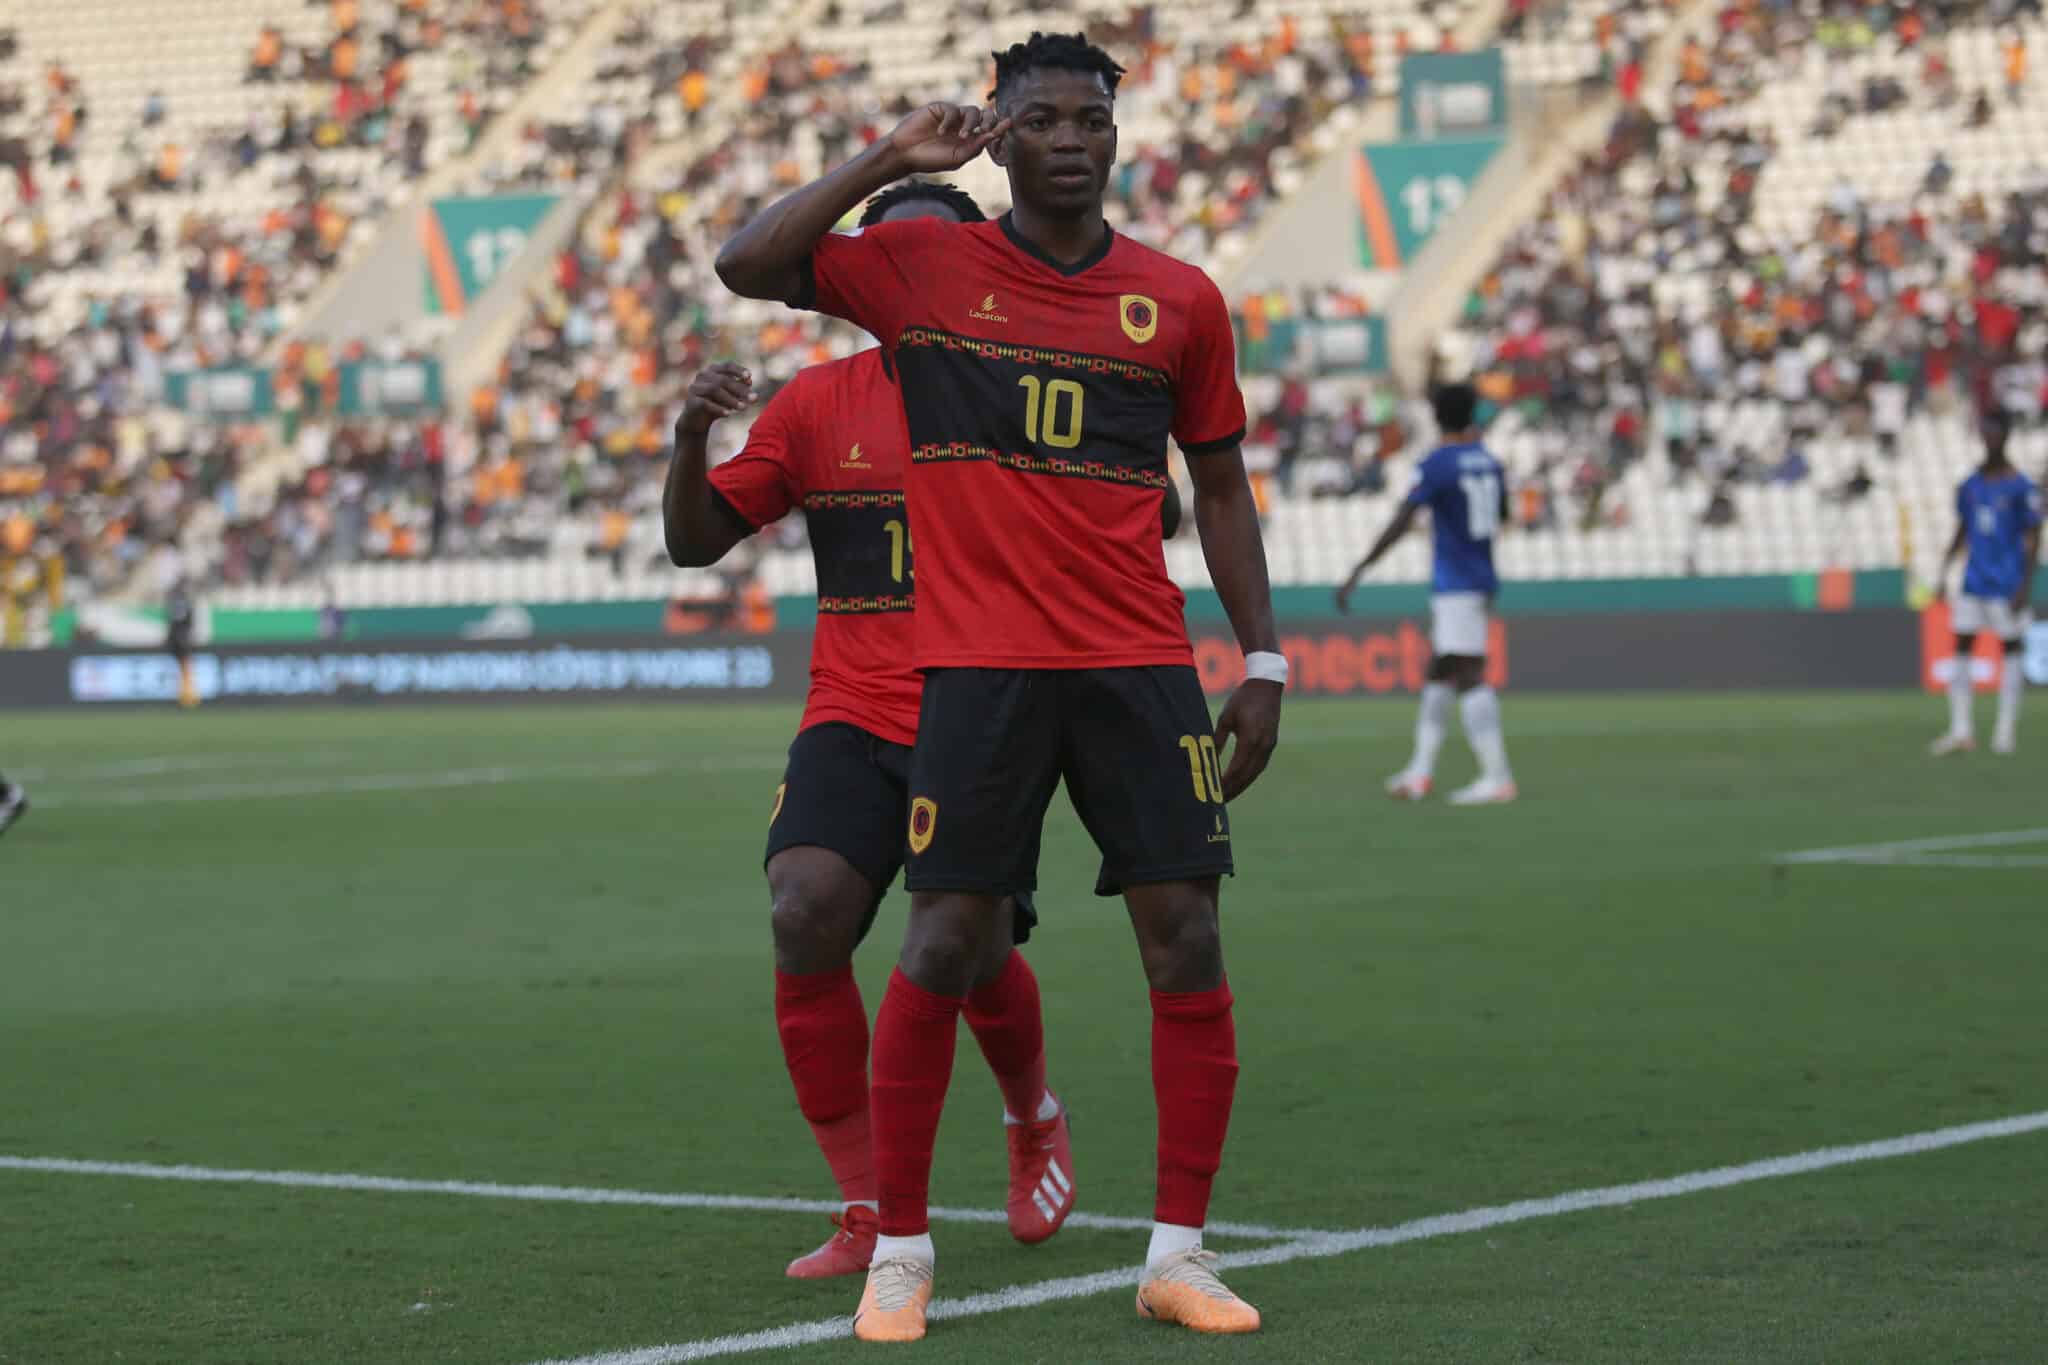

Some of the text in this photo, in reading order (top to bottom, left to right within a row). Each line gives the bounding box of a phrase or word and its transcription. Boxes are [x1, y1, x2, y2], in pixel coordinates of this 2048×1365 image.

[1017, 373, 1085, 449] 10
[883, 519, 914, 583] 1
[1179, 735, 1224, 804] 10
